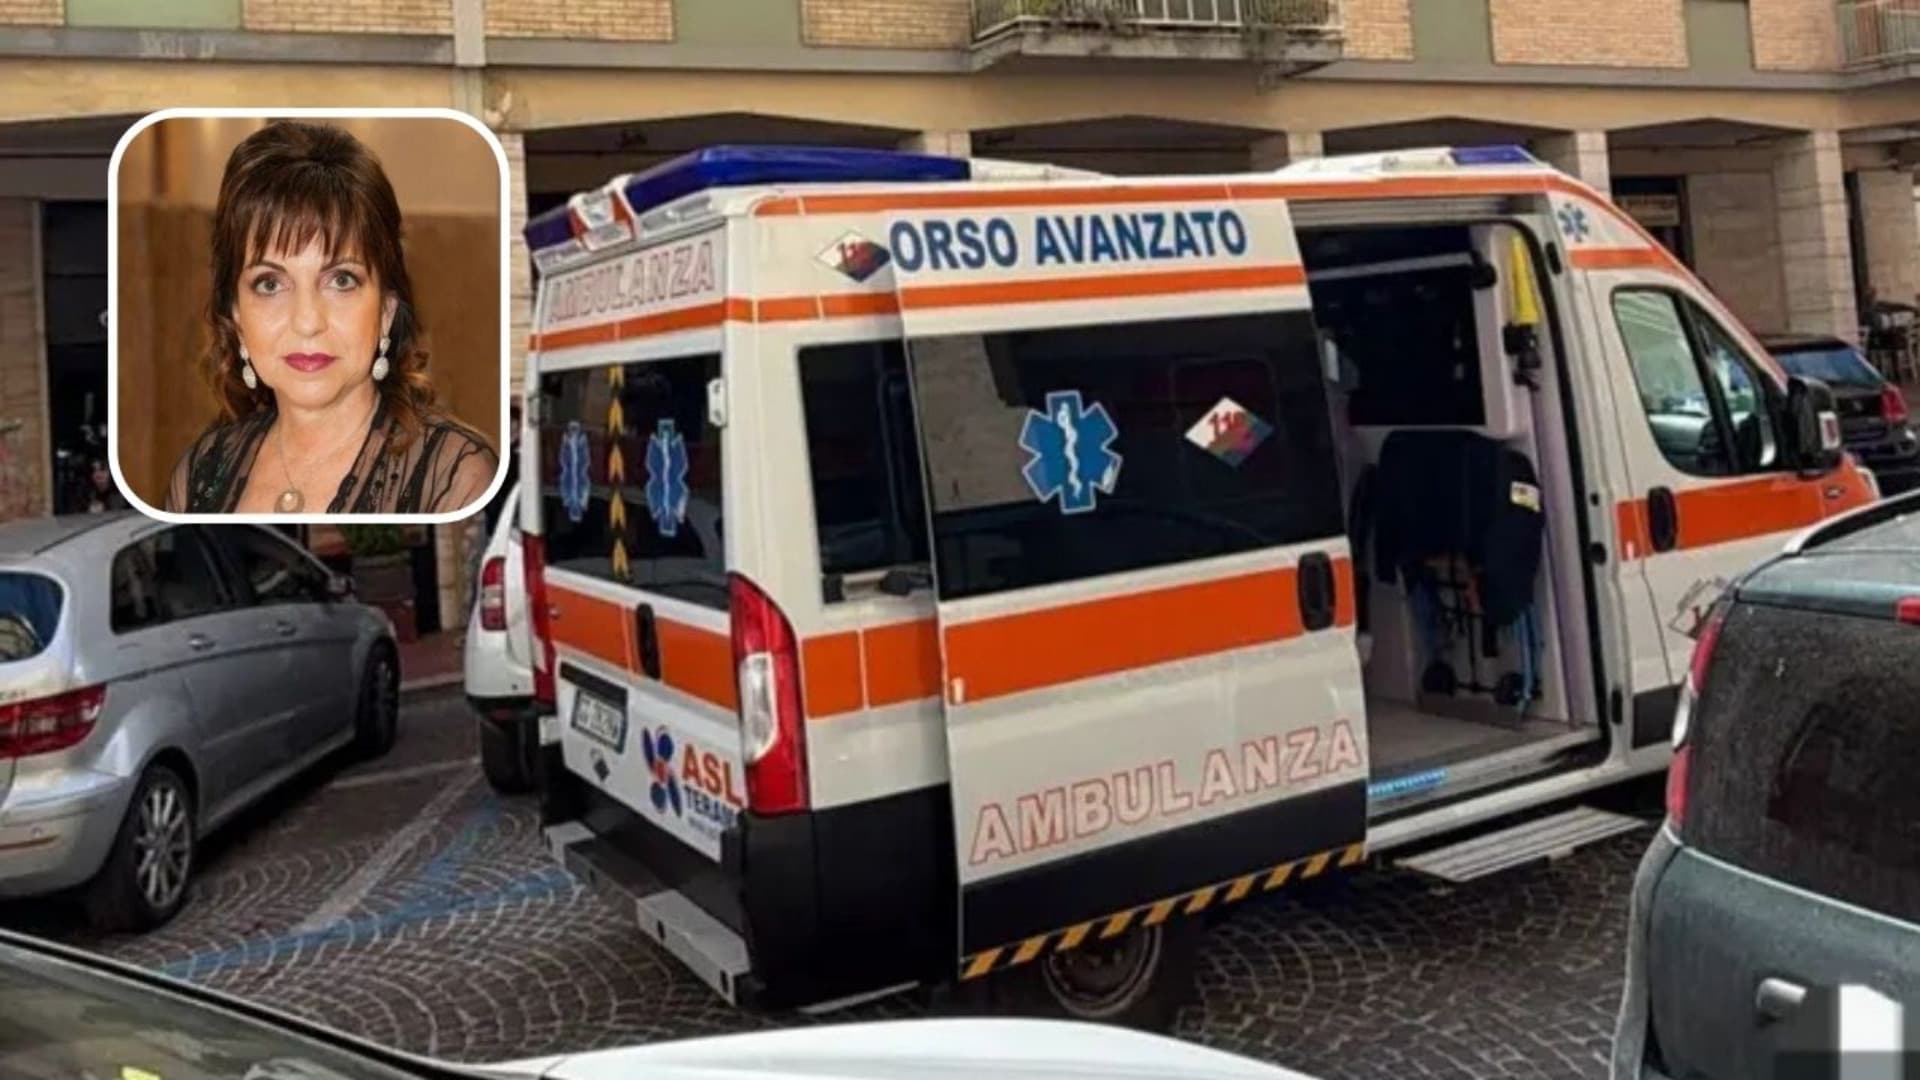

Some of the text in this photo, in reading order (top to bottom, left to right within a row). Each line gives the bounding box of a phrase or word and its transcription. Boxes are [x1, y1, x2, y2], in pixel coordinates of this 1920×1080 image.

[1034, 209, 1248, 266] AVANZATO
[548, 240, 715, 324] AMBULANZA
[682, 743, 743, 808] ASL
[968, 719, 1363, 866] AMBULANZA
